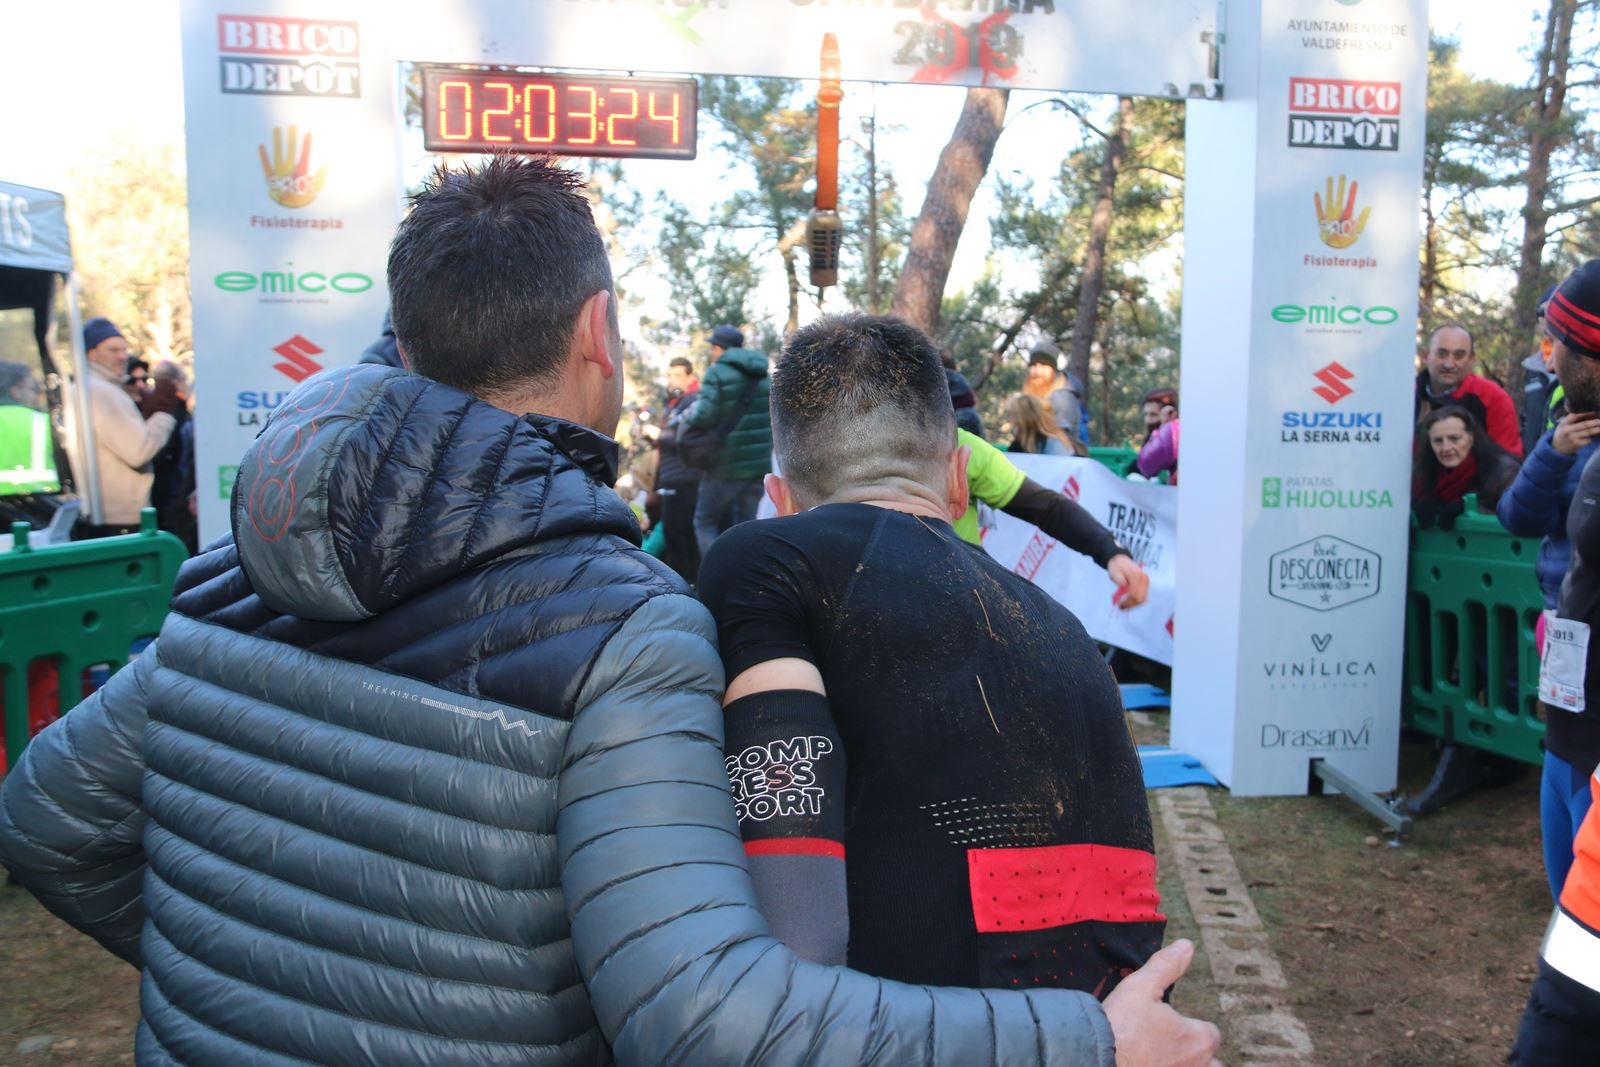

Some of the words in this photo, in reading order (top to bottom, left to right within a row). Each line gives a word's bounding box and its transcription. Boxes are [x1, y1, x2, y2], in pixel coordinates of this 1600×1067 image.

[222, 19, 358, 53] BRICO
[1287, 19, 1388, 34] AYUNTAMIENTO
[1391, 24, 1408, 36] DE
[893, 20, 1024, 69] 2019
[1302, 36, 1392, 52] VALDEFRESNO
[1294, 82, 1398, 110] BRICO
[251, 215, 343, 230] Fisioterapia
[1303, 254, 1377, 269] Fisioterapia
[214, 262, 373, 293] emico
[1271, 296, 1399, 325] emico
[1282, 412, 1382, 428] SUZUKI
[1281, 431, 1299, 442] LA
[1304, 431, 1350, 442] SERNA
[1355, 431, 1380, 442] 4X4
[1286, 476, 1334, 487] PATATAS
[1286, 490, 1393, 508] HIJOLUSA
[1108, 502, 1156, 538] TRANS
[1280, 558, 1370, 580] DESCONECTA
[362, 682, 418, 702] TREKKING
[1261, 721, 1371, 748] Drasanvi
